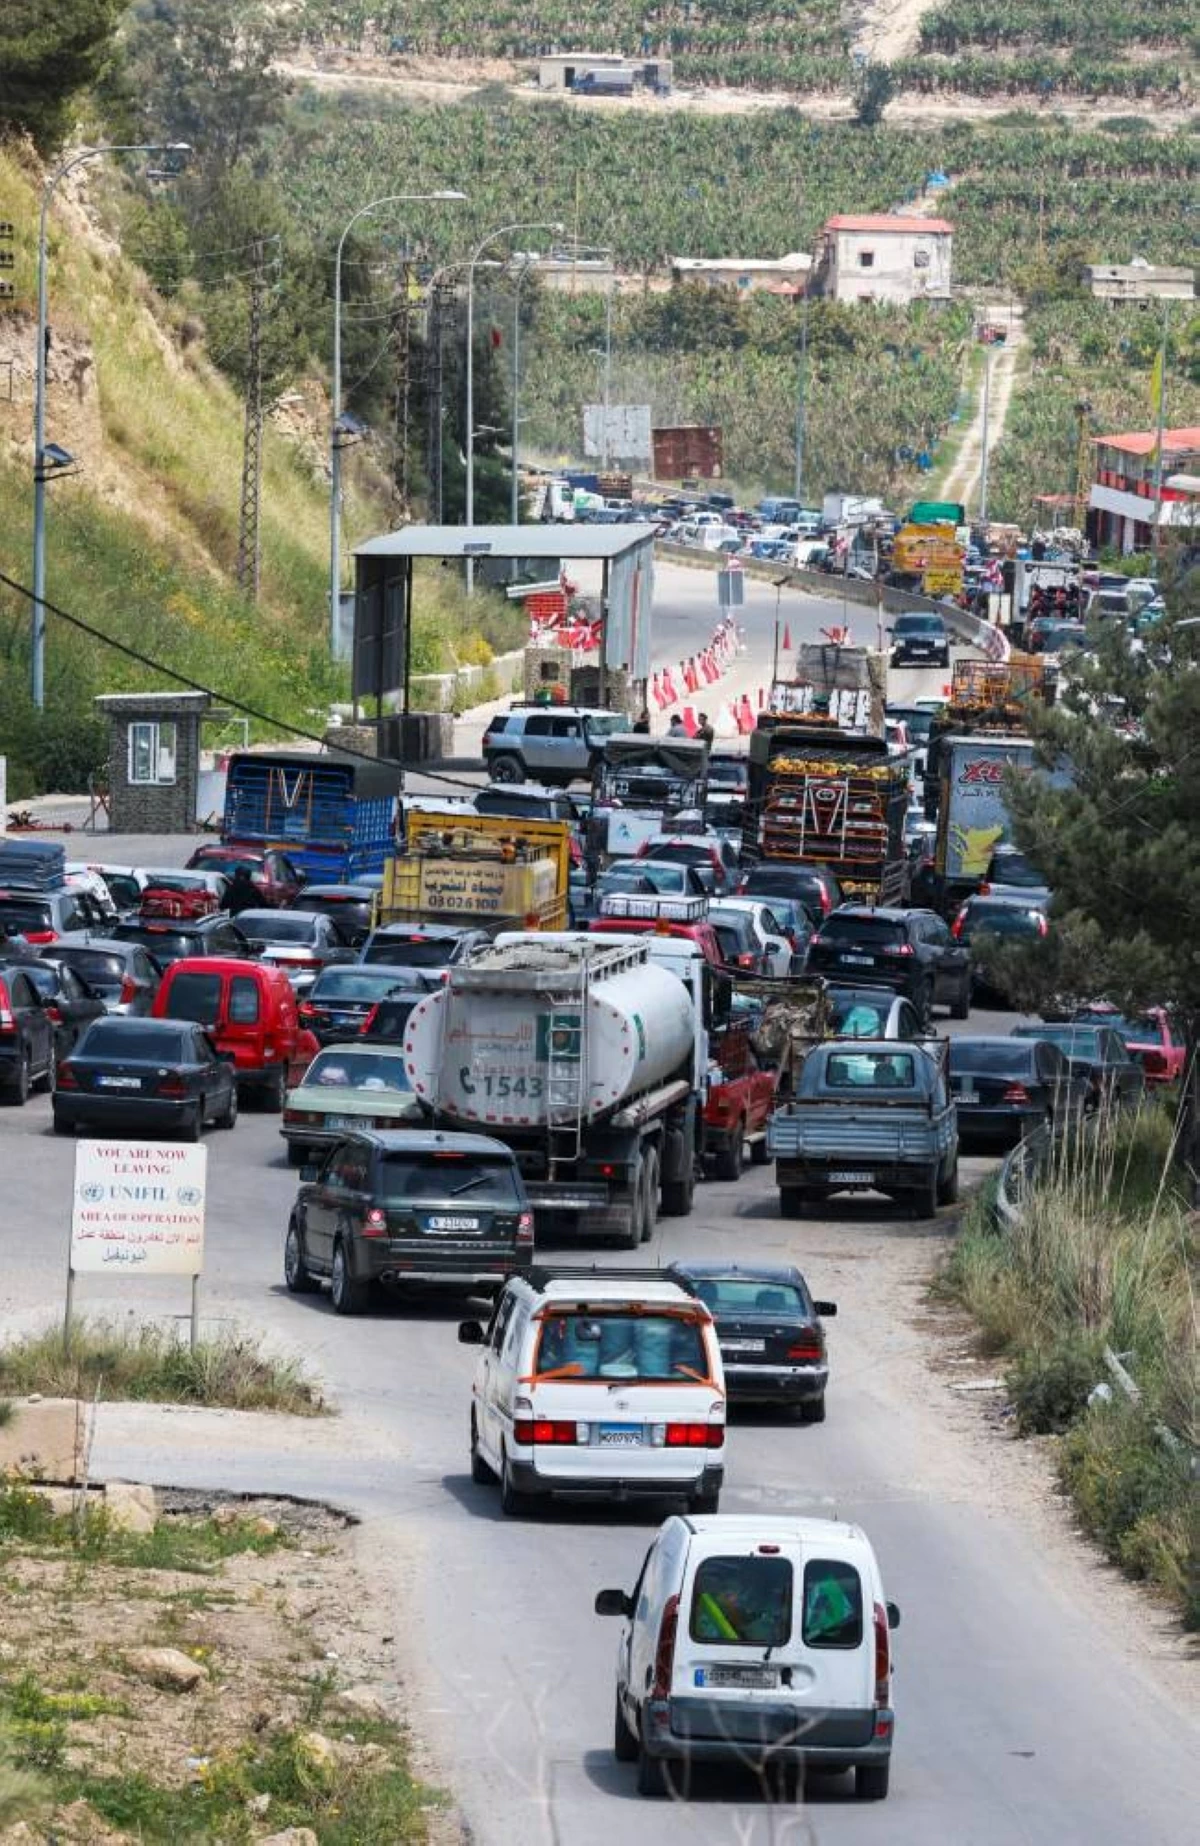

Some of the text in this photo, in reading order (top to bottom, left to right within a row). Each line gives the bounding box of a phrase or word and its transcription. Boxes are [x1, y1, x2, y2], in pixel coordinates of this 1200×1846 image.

[483, 1075, 543, 1098] 1543
[96, 1146, 187, 1160] YOU ARE NOW
[113, 1163, 171, 1175] LEAVING
[109, 1184, 170, 1201] UNIFIL
[80, 1211, 201, 1225] AREA OF OPERATION
